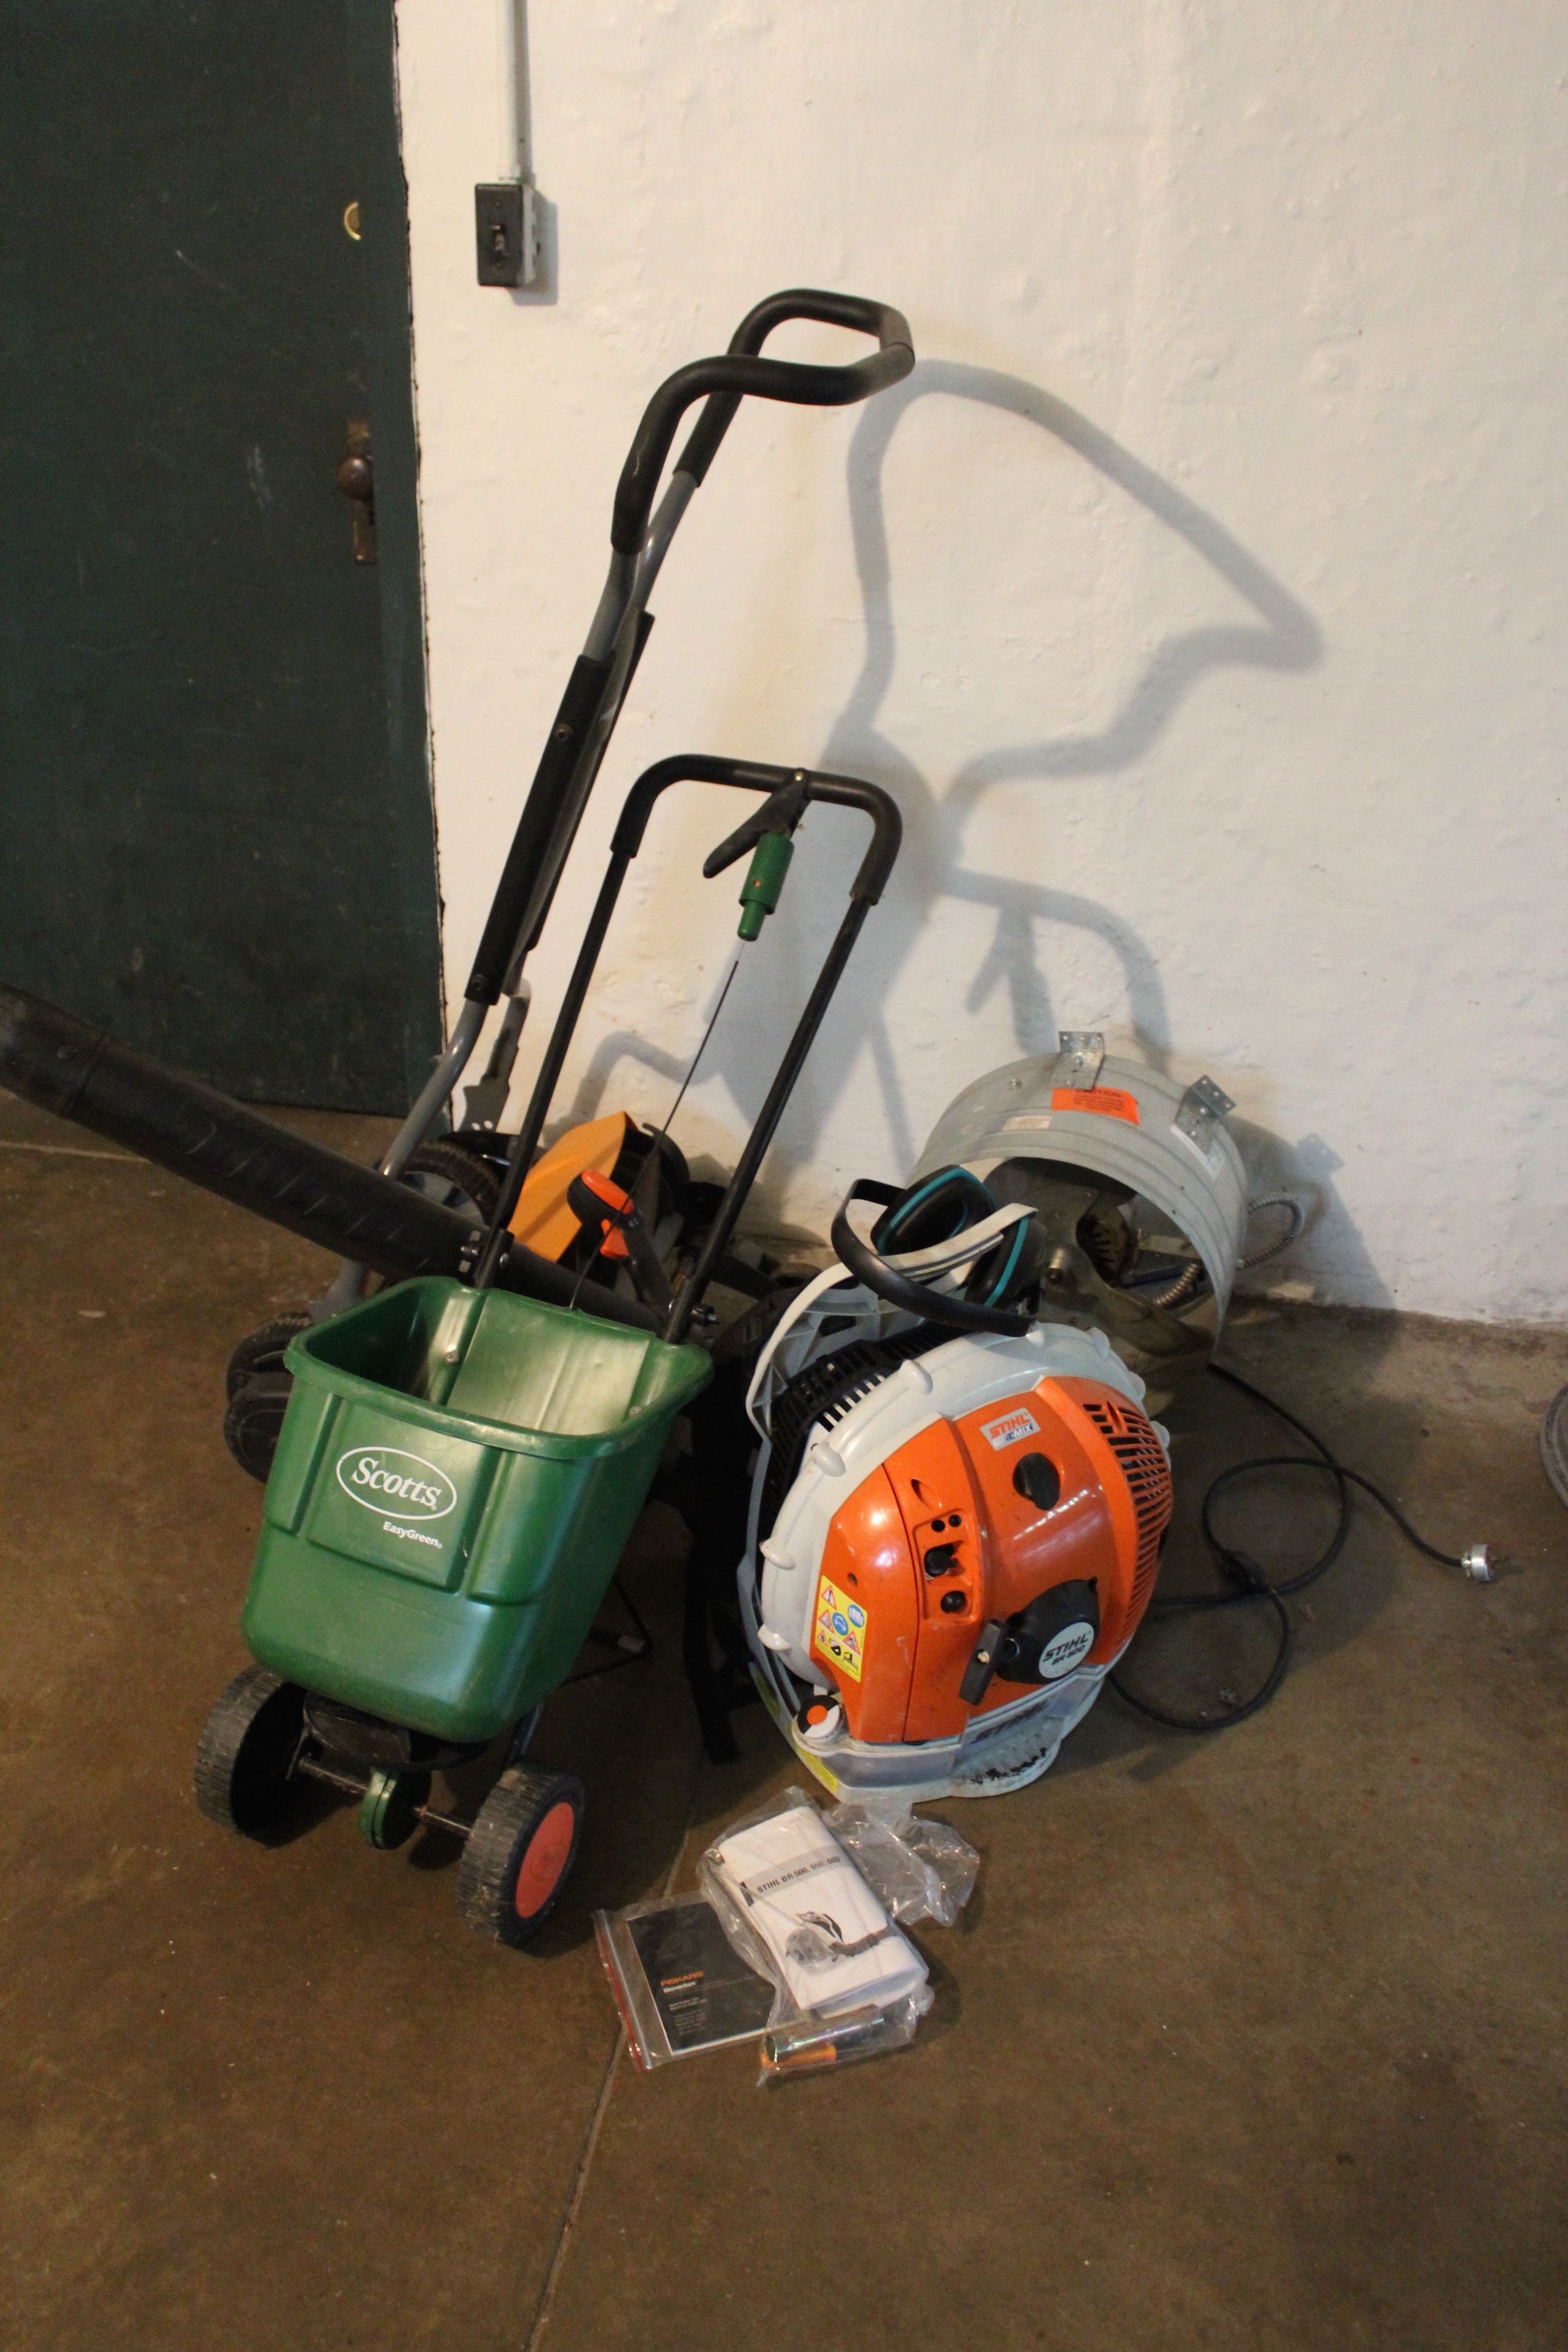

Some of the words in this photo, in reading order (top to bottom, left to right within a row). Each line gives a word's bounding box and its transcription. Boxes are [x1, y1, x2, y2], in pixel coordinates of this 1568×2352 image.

[990, 1414, 1030, 1439] STIHL
[350, 1457, 442, 1506] Scotts
[383, 1521, 439, 1546] EasyGreen
[1043, 1634, 1088, 1662] STIHL
[757, 1879, 779, 1893] STIHL
[781, 1873, 794, 1882] BR
